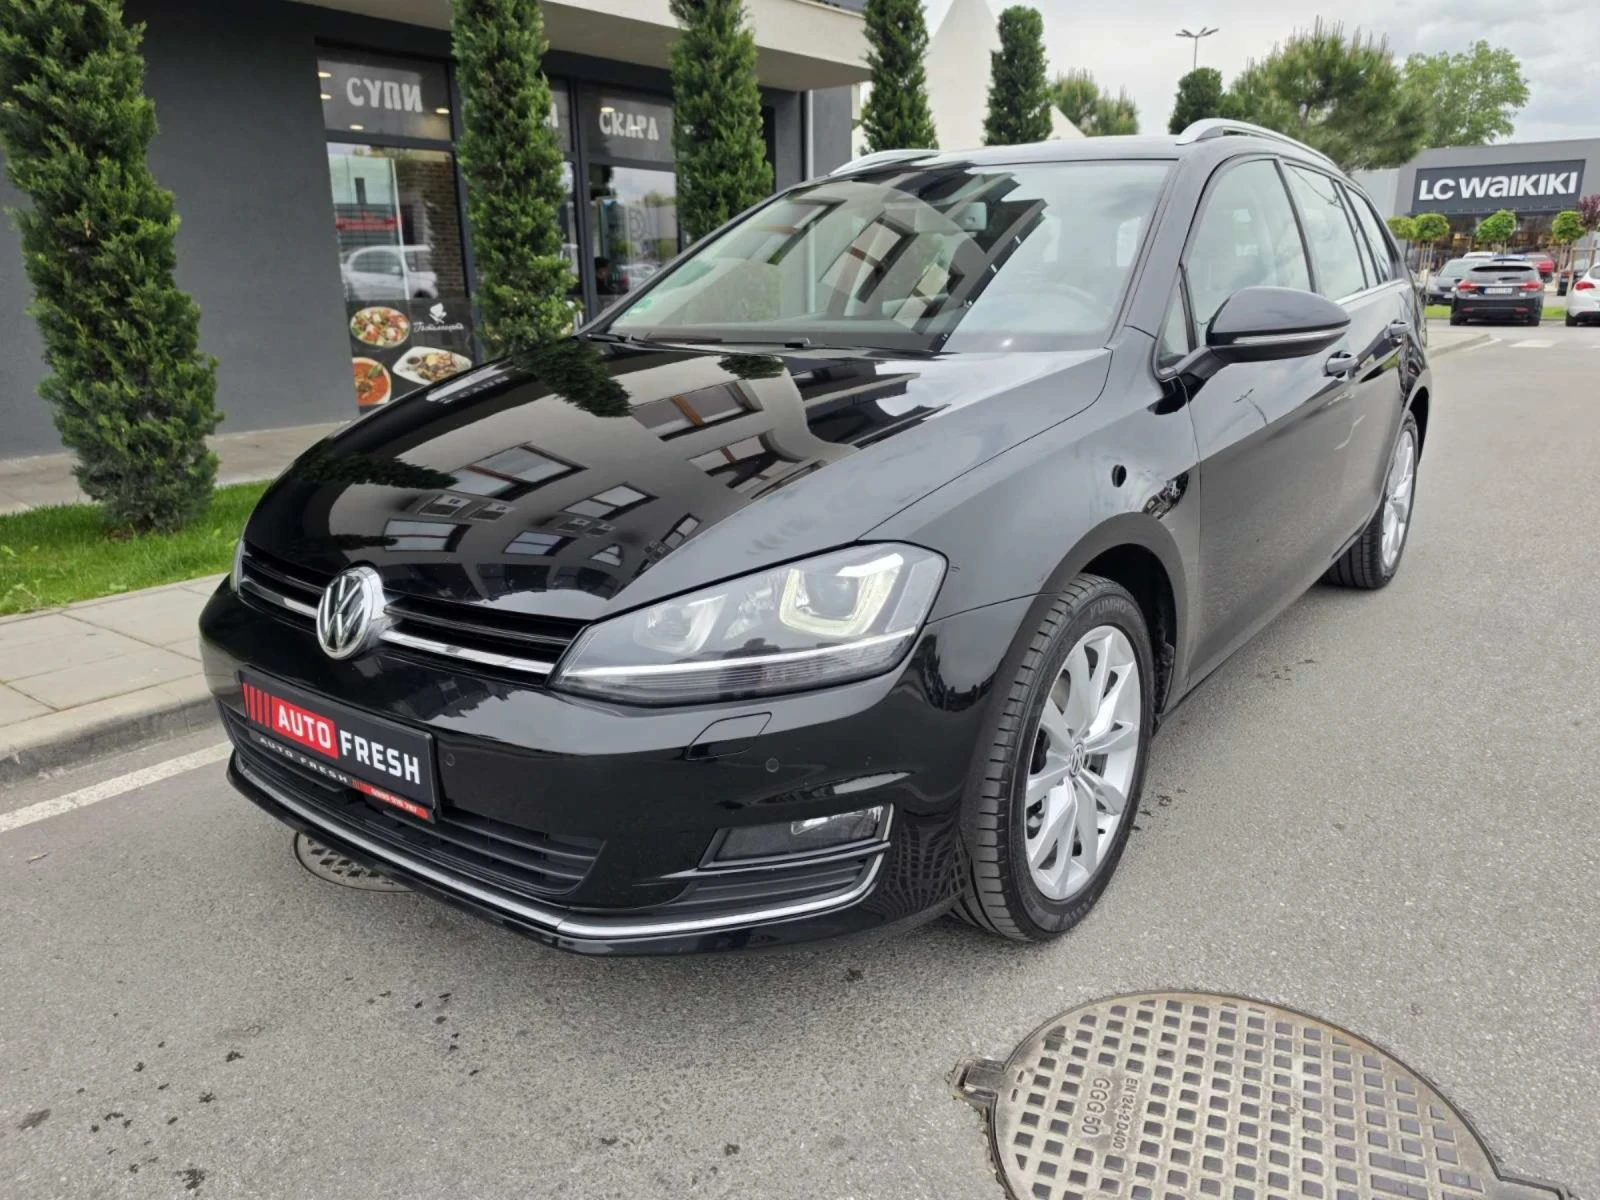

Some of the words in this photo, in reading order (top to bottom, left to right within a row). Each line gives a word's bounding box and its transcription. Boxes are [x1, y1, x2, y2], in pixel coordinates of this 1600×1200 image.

[347, 77, 423, 112] СУПИ
[599, 112, 660, 141] СКАРА
[1419, 178, 1456, 200] LC
[259, 737, 293, 759] AUTO
[300, 757, 349, 783] FRESH
[278, 704, 332, 749] AUTO
[339, 729, 420, 785] FRESH
[1125, 1077, 1138, 1093] EN
